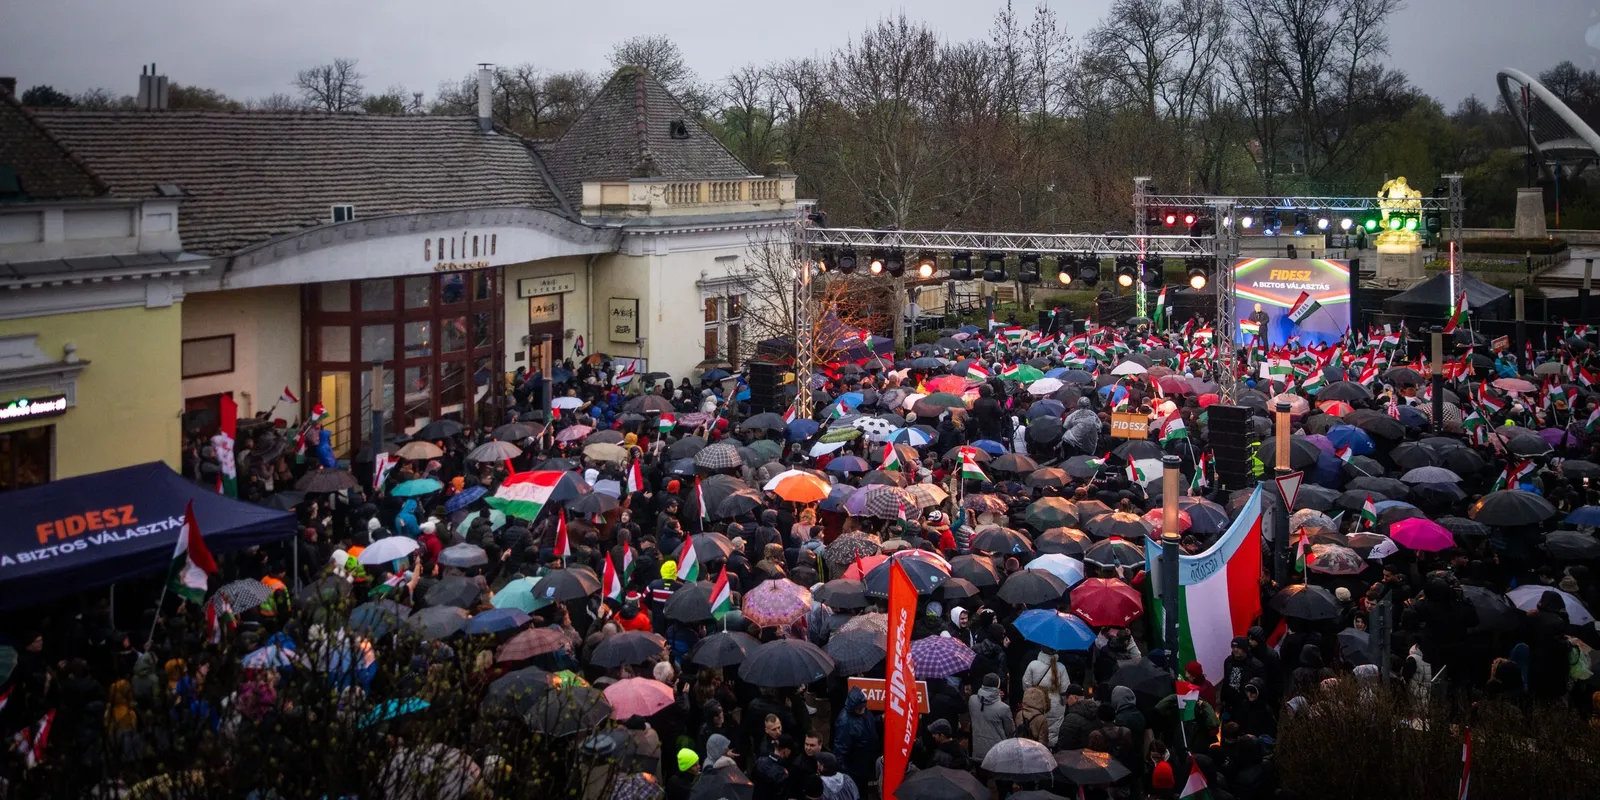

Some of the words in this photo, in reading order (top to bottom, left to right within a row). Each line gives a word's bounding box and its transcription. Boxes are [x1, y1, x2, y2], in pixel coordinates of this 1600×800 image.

[424, 231, 497, 262] GALÉRIA
[1270, 269, 1312, 281] FIDESZ
[1259, 281, 1286, 289] BIZTOS
[1286, 282, 1330, 291] VÁLASZTÁS
[1112, 420, 1147, 431] FIDESZ
[36, 503, 138, 544] FIDESZ
[1, 551, 16, 567] A
[16, 539, 88, 564] BIZTOS
